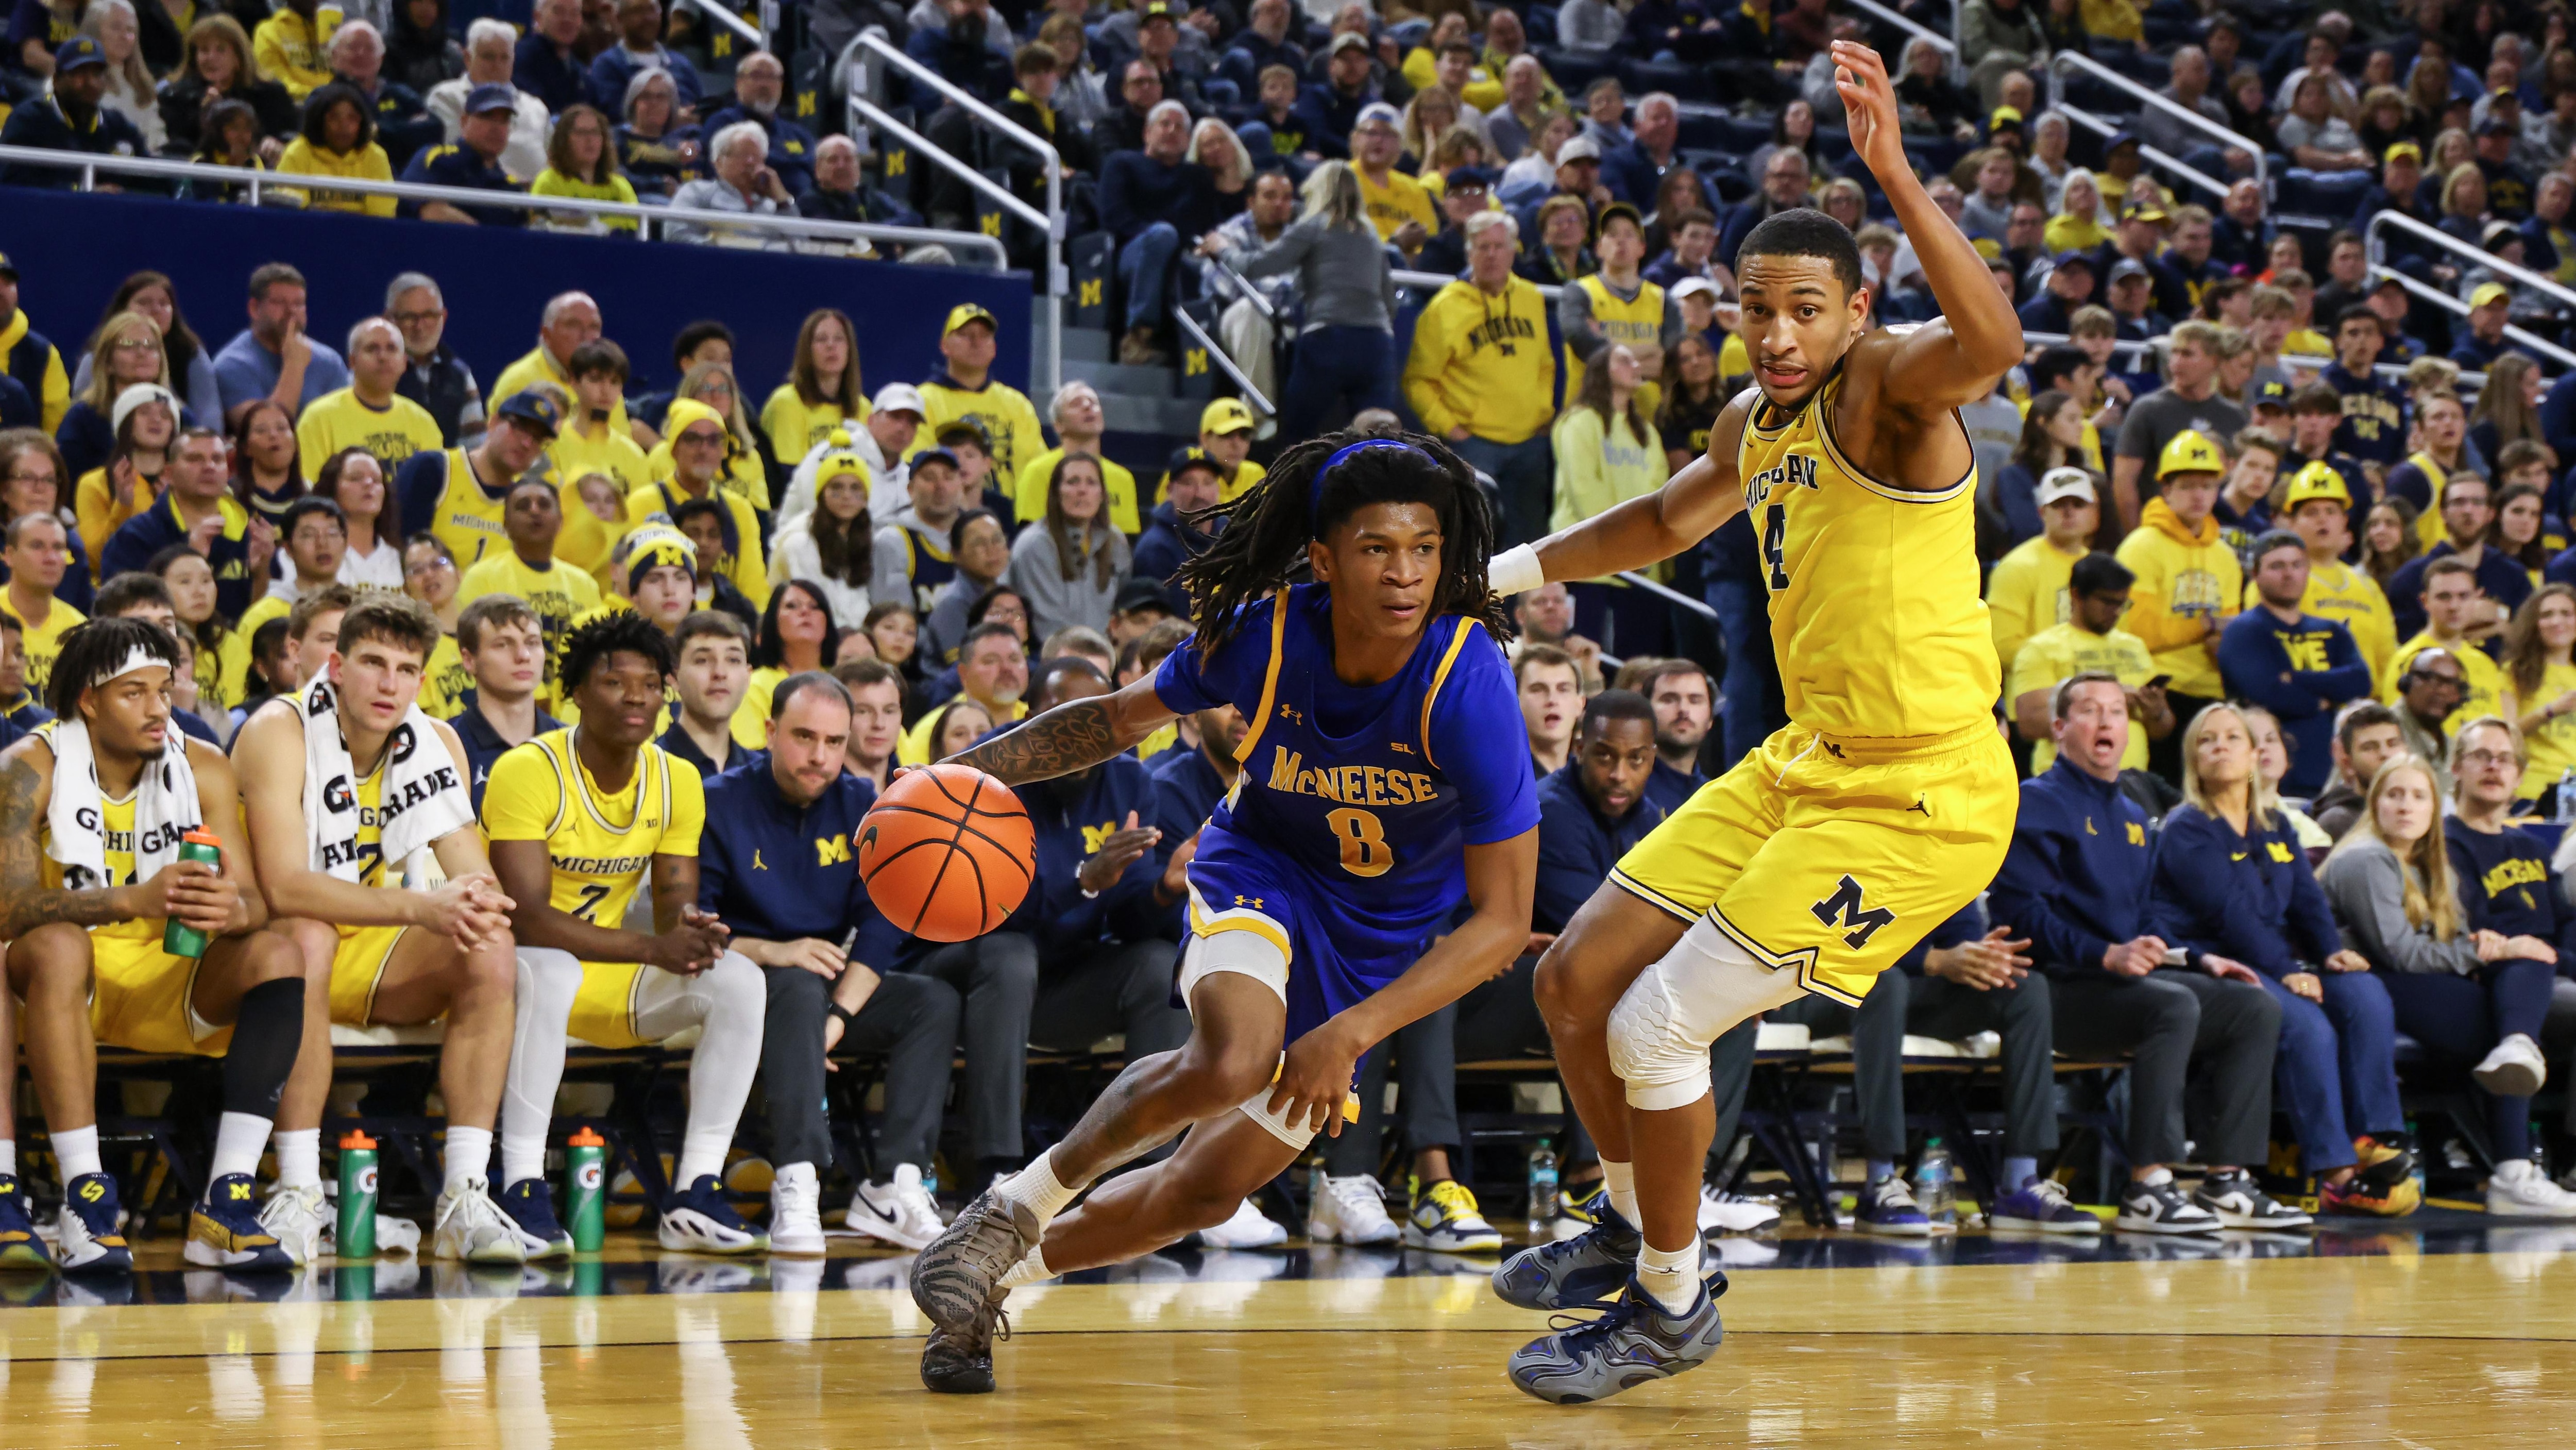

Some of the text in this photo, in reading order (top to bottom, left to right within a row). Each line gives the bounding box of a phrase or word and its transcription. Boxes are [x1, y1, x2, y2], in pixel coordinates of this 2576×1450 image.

[713, 32, 731, 58] M
[798, 90, 816, 118] M
[887, 149, 905, 176] M
[980, 212, 1001, 238] M
[1079, 278, 1101, 308] M
[1185, 347, 1208, 377] M
[656, 546, 684, 566] M
[1764, 503, 1790, 591] 4
[1391, 741, 1416, 756] SL
[815, 833, 852, 868] M
[1080, 820, 1116, 854] M
[1325, 807, 1395, 878] 8
[551, 854, 652, 875] MICHIGAN
[1809, 872, 1897, 951] M
[359, 1166, 378, 1194] G
[579, 1162, 603, 1190] G
[228, 1183, 251, 1201] M
